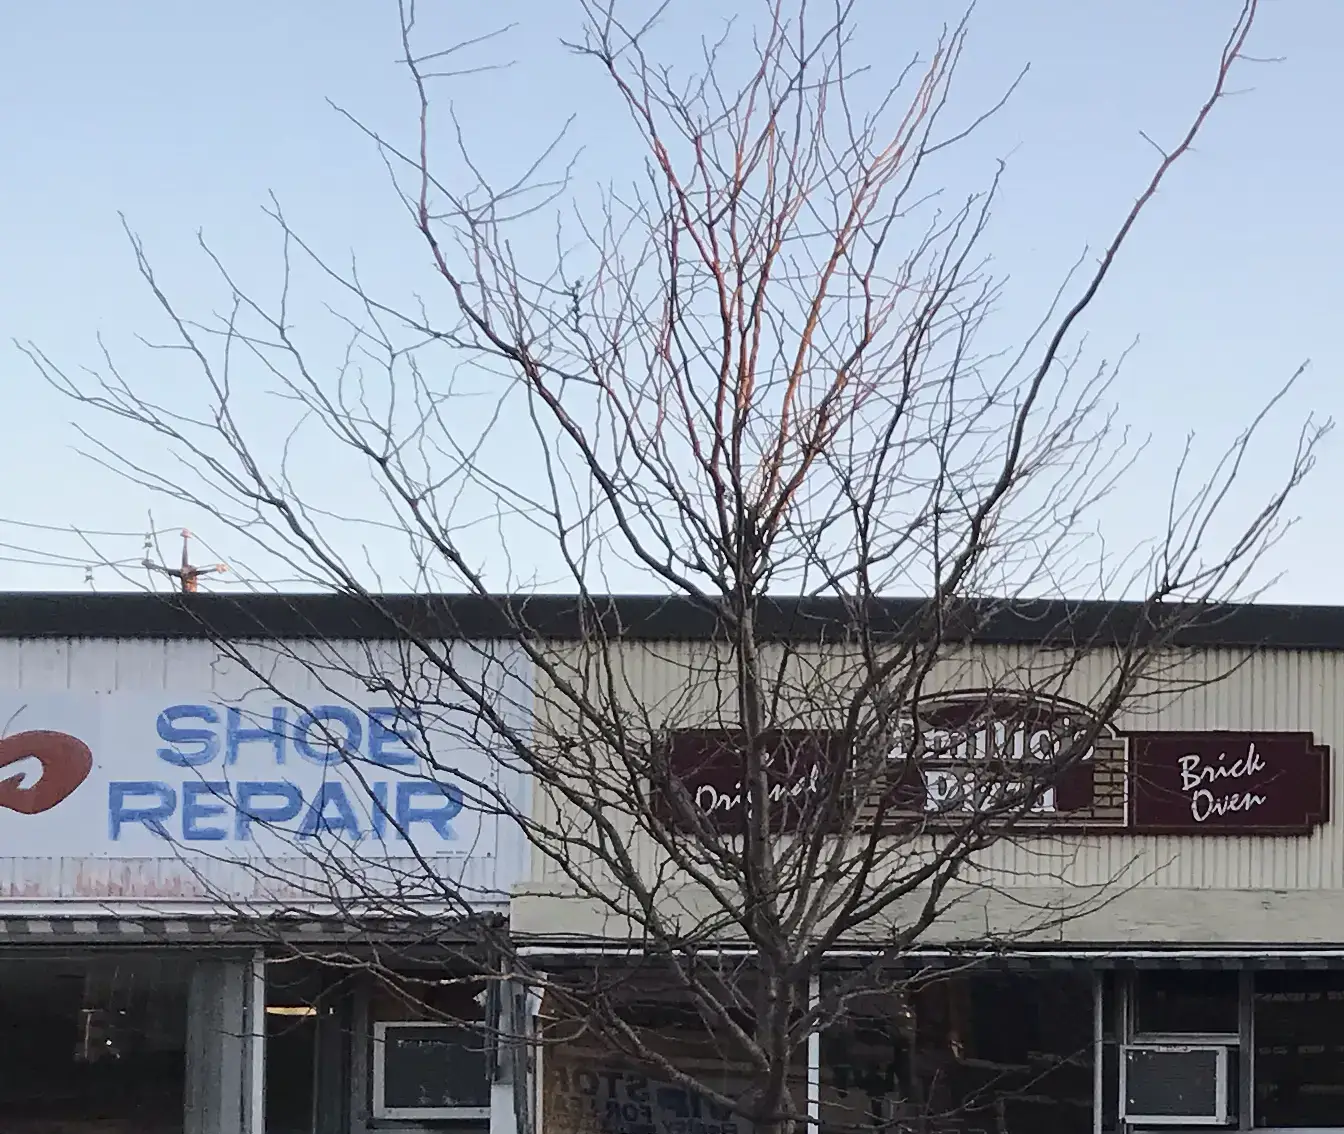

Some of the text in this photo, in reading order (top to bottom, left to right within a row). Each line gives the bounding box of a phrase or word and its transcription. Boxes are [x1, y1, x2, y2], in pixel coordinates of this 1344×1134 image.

[156, 704, 421, 767] SHOE
[695, 763, 819, 820] Orinal
[1178, 743, 1266, 793] Brick
[108, 781, 464, 841] REPAIR
[1191, 789, 1266, 824] Oven
